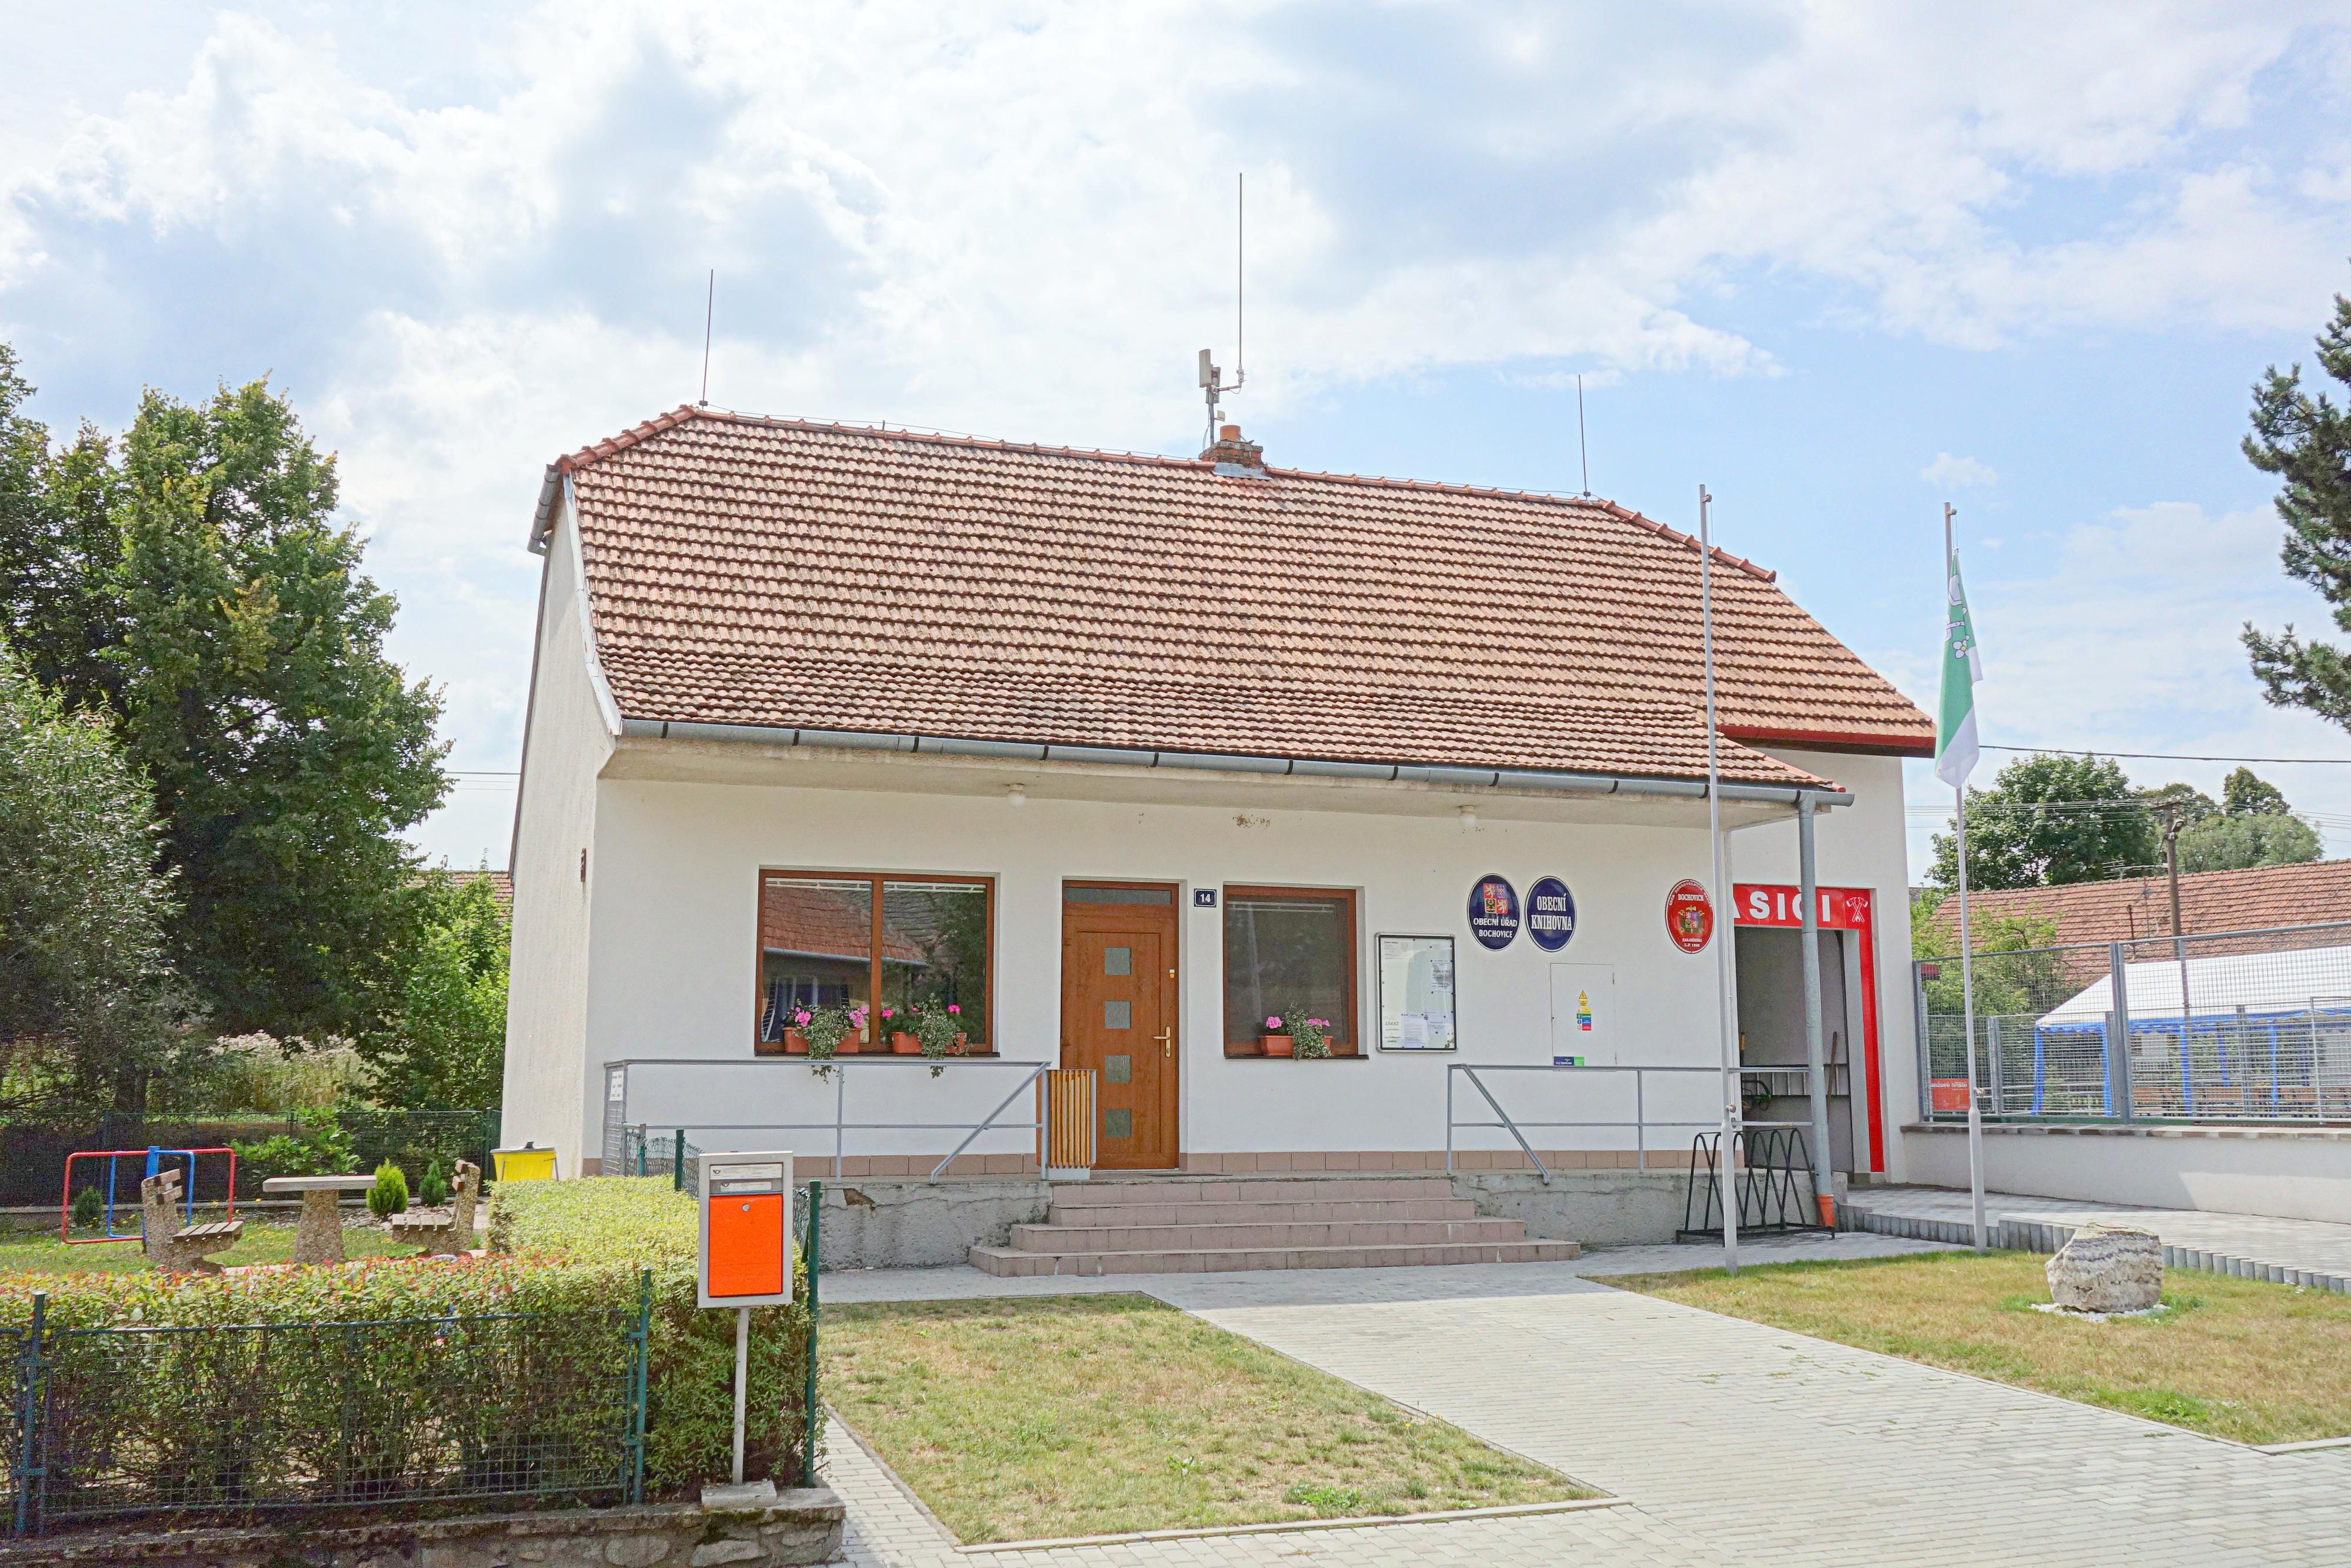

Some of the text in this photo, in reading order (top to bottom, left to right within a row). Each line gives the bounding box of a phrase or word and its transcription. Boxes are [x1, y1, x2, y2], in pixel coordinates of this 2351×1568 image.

[1200, 893, 1211, 903] 14
[1536, 893, 1566, 912] OBECNÍ
[1677, 893, 1704, 902] BOCHOVICE
[1733, 886, 1831, 922] SII
[1473, 917, 1518, 927] OBECNÍ ÚŘAD
[1531, 914, 1572, 930] KNIHOVNA
[1479, 929, 1513, 938] BOCHOVICE
